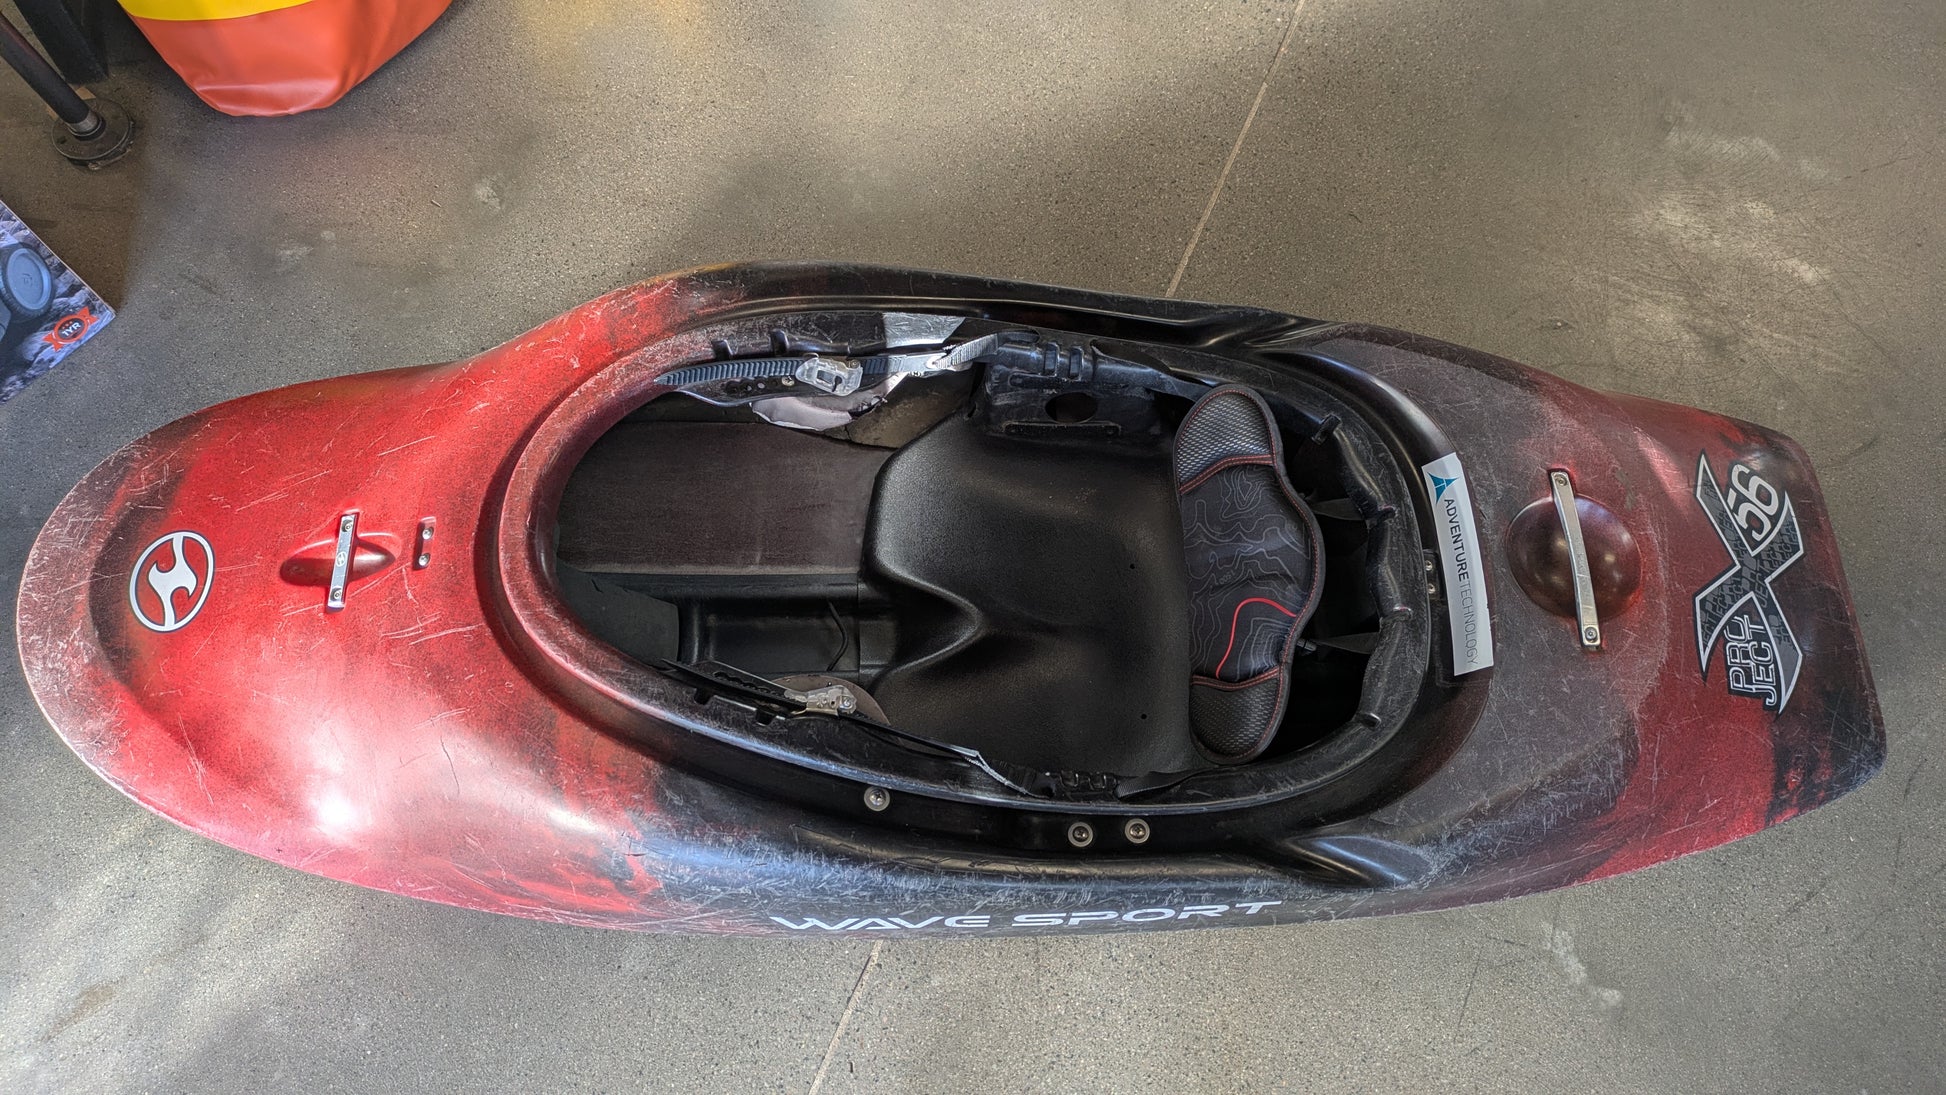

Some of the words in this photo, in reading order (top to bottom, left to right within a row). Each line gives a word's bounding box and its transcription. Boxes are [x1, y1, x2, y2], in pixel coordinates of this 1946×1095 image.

[1727, 464, 1779, 542] 56
[770, 915, 991, 931] WAVE
[1011, 900, 1283, 927] SPORT
